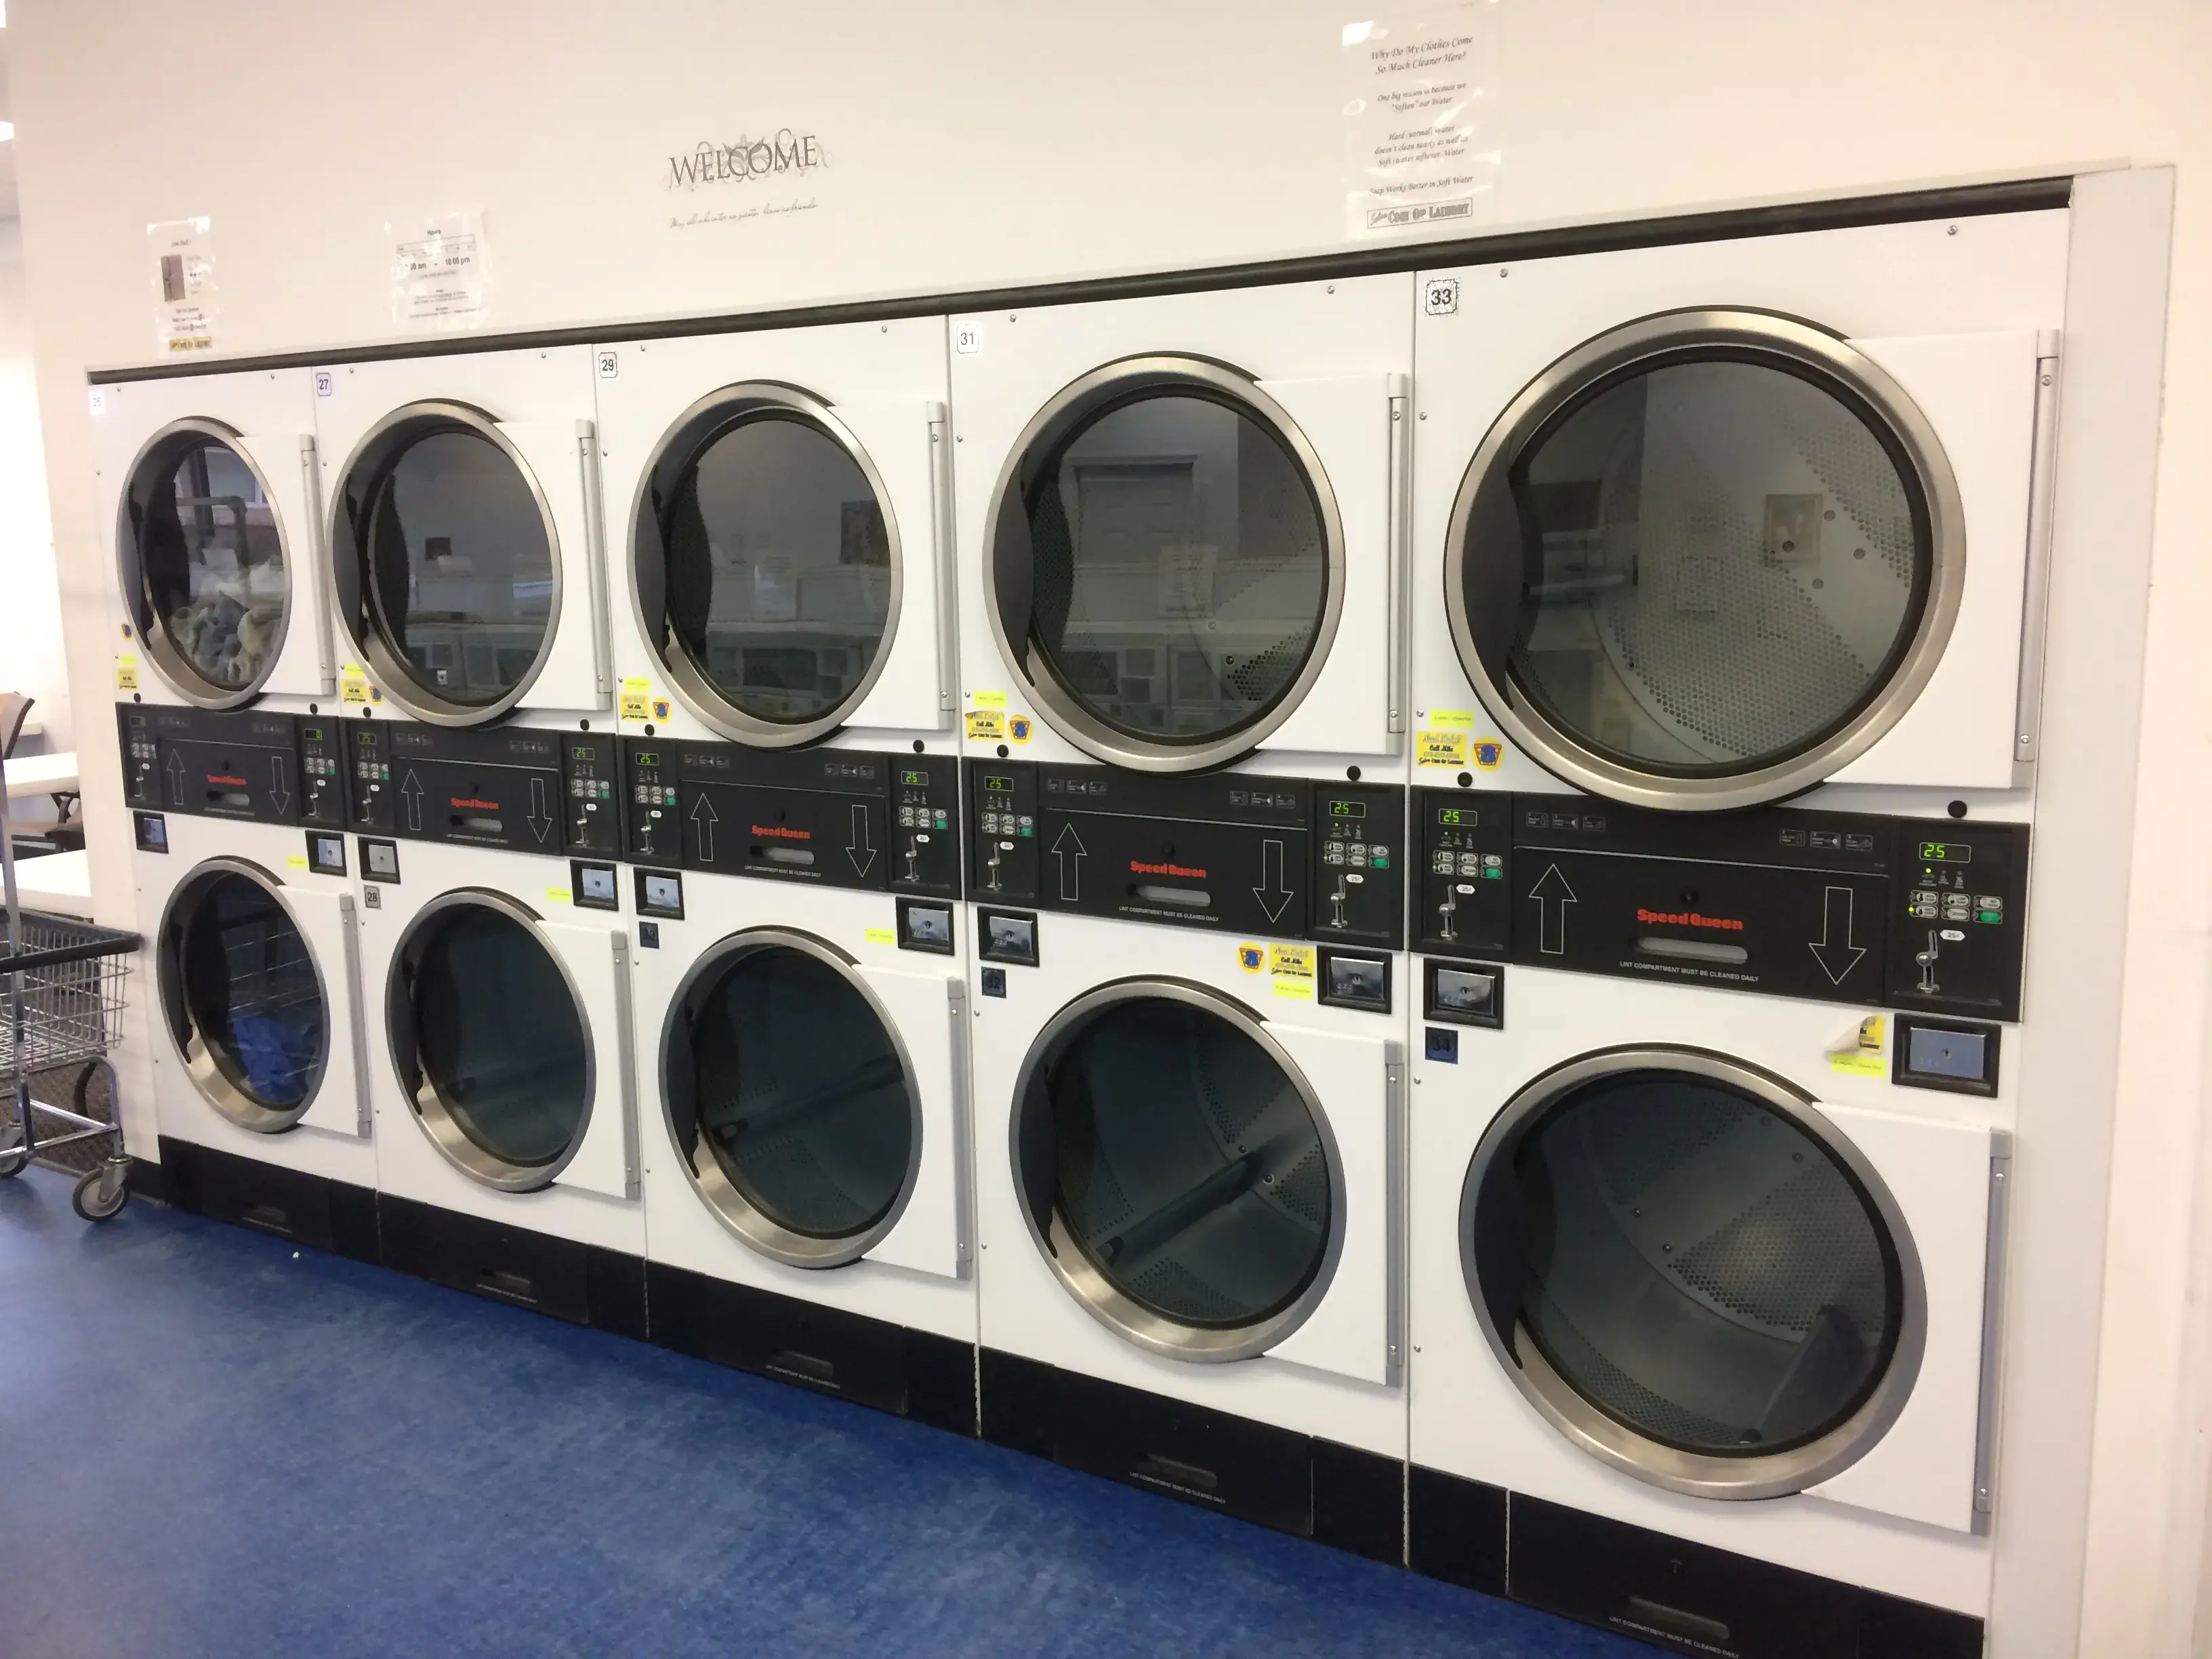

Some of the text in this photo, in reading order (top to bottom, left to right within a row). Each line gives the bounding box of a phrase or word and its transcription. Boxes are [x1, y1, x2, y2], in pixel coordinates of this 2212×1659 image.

[1372, 37, 1473, 61] Why Do My Clothes Come
[1376, 51, 1467, 75] So Much Cleaner Here?
[1391, 91, 1401, 101] big
[1431, 84, 1455, 94] because
[1432, 96, 1452, 105] Water
[1389, 130, 1405, 141] Hard
[1398, 142, 1414, 152] clean
[668, 136, 817, 186] WELCOME
[1387, 184, 1407, 193] Works
[1408, 182, 1429, 190] Better
[1437, 177, 1451, 188] Soft
[1453, 176, 1473, 184] Water
[445, 257, 459, 266] 10:00
[461, 256, 470, 265] pm
[1431, 288, 1452, 306] 33
[960, 332, 973, 345] 31
[602, 359, 614, 371] 29
[319, 379, 329, 390] 27
[577, 748, 586, 758] 25
[640, 753, 651, 764] 25
[906, 773, 918, 783] 25
[989, 778, 1002, 789] 25
[1334, 802, 1349, 814] 25
[1443, 810, 1460, 823] 25
[1924, 844, 1945, 858] 25
[1130, 861, 1207, 878] Speed Queen
[367, 891, 377, 902] 28
[1637, 908, 1744, 930] Speed Queen
[1633, 962, 1680, 974] COMPARTMENT
[1681, 967, 1698, 976] MUST
[1700, 969, 1709, 977] BE
[1709, 970, 1741, 981] CLEANED
[1741, 975, 1760, 983] DAILY
